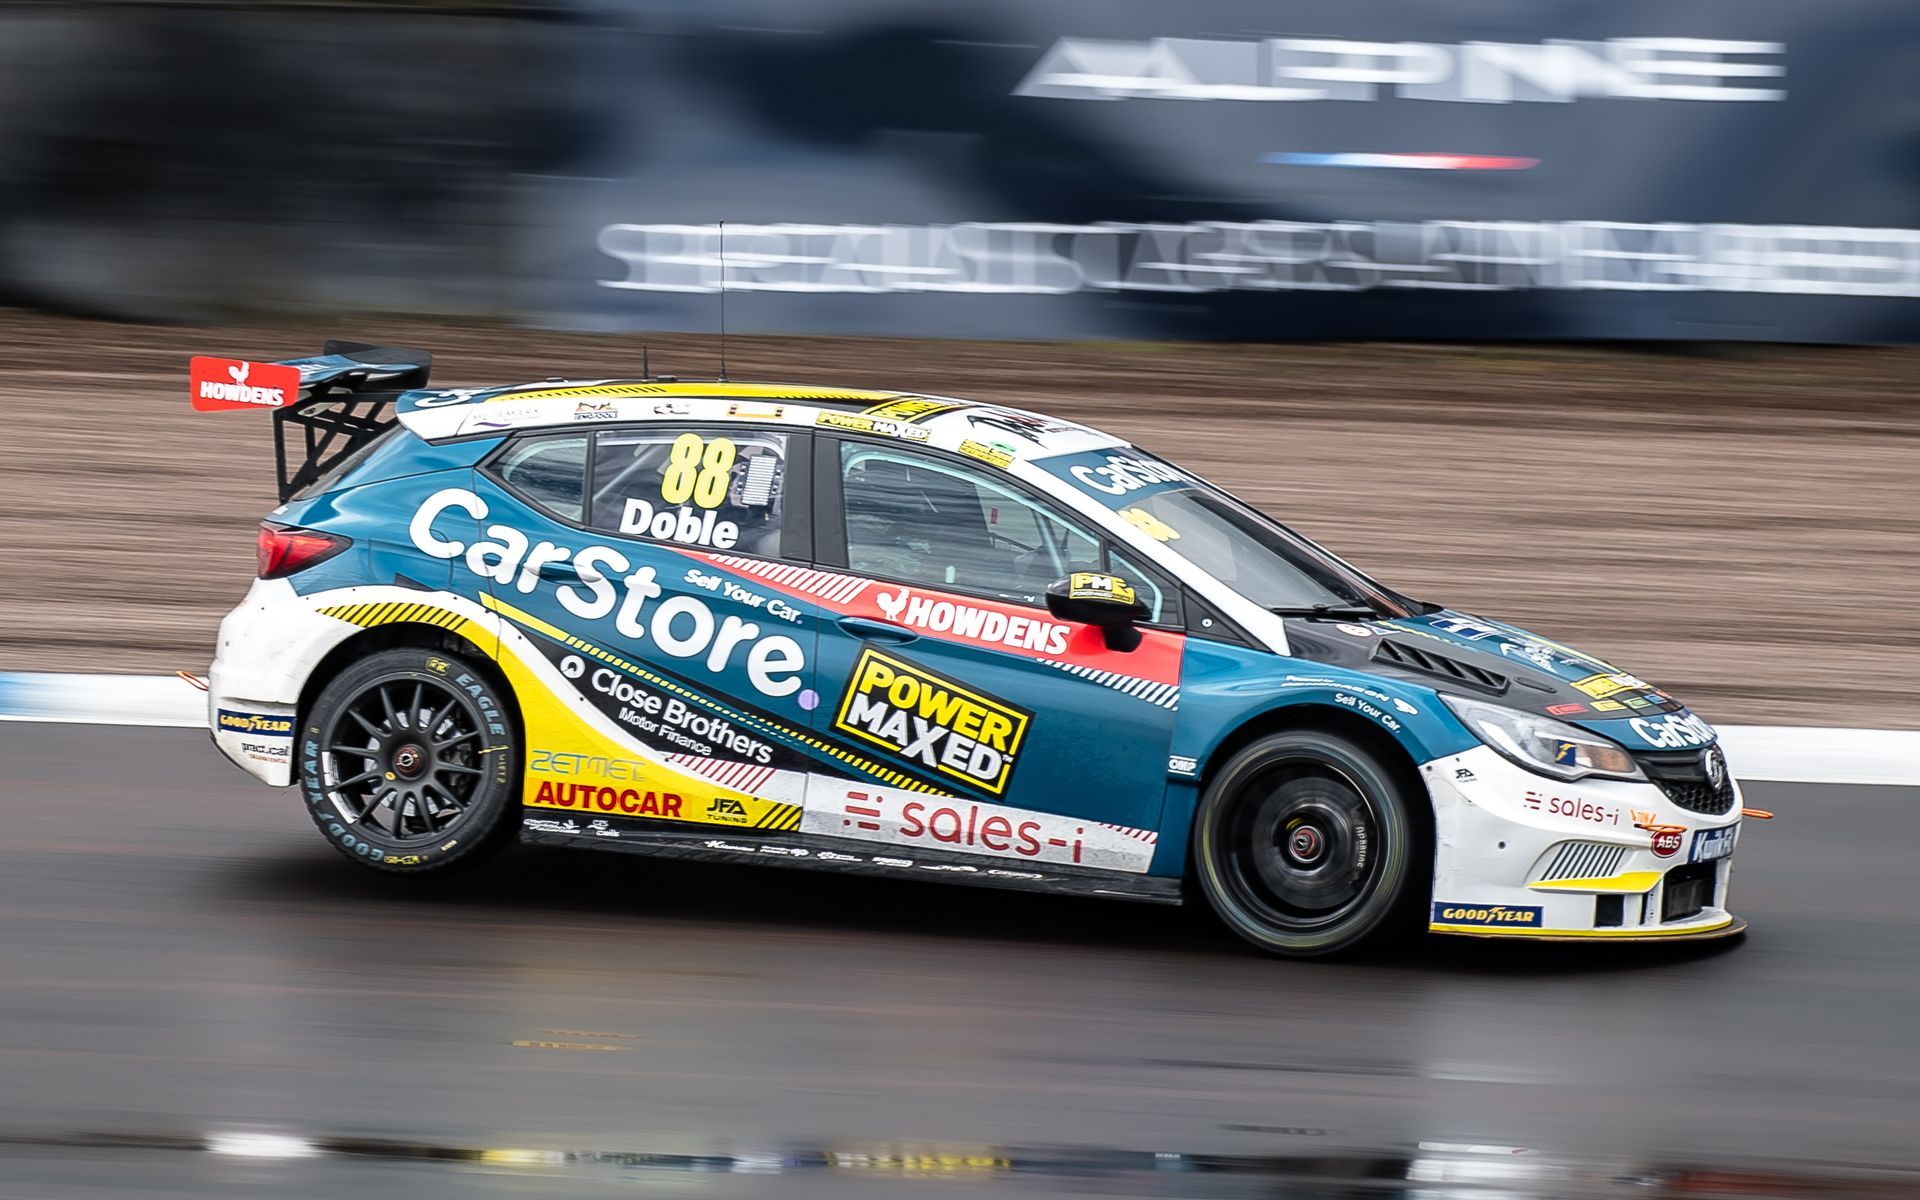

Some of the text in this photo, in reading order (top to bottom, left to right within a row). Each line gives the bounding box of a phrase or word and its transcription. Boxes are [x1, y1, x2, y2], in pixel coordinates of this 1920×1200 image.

[200, 381, 284, 407] HOWDENS
[818, 413, 873, 430] POWER
[661, 433, 736, 508] 88
[619, 498, 739, 549] Doble
[684, 569, 723, 591] Sell
[723, 581, 767, 608] Your
[903, 596, 1072, 655] HOWDENS
[220, 715, 292, 732] GOODYEAR
[455, 673, 506, 736] EAGLE
[591, 668, 774, 764] Close Brothers
[858, 660, 1013, 752] POWER
[1333, 693, 1357, 707] Sell
[1357, 699, 1382, 718] Your
[618, 707, 713, 756] Motor Finance
[846, 692, 1002, 780] MAXED
[303, 740, 385, 862] GOODYEAR
[534, 781, 682, 818] AUTOCAR
[706, 797, 748, 816] JFA
[1548, 797, 1619, 826] sales-i
[900, 801, 1084, 864] sales-i
[1656, 834, 1681, 849] ABS
[1442, 906, 1535, 924] GOODYEAR
